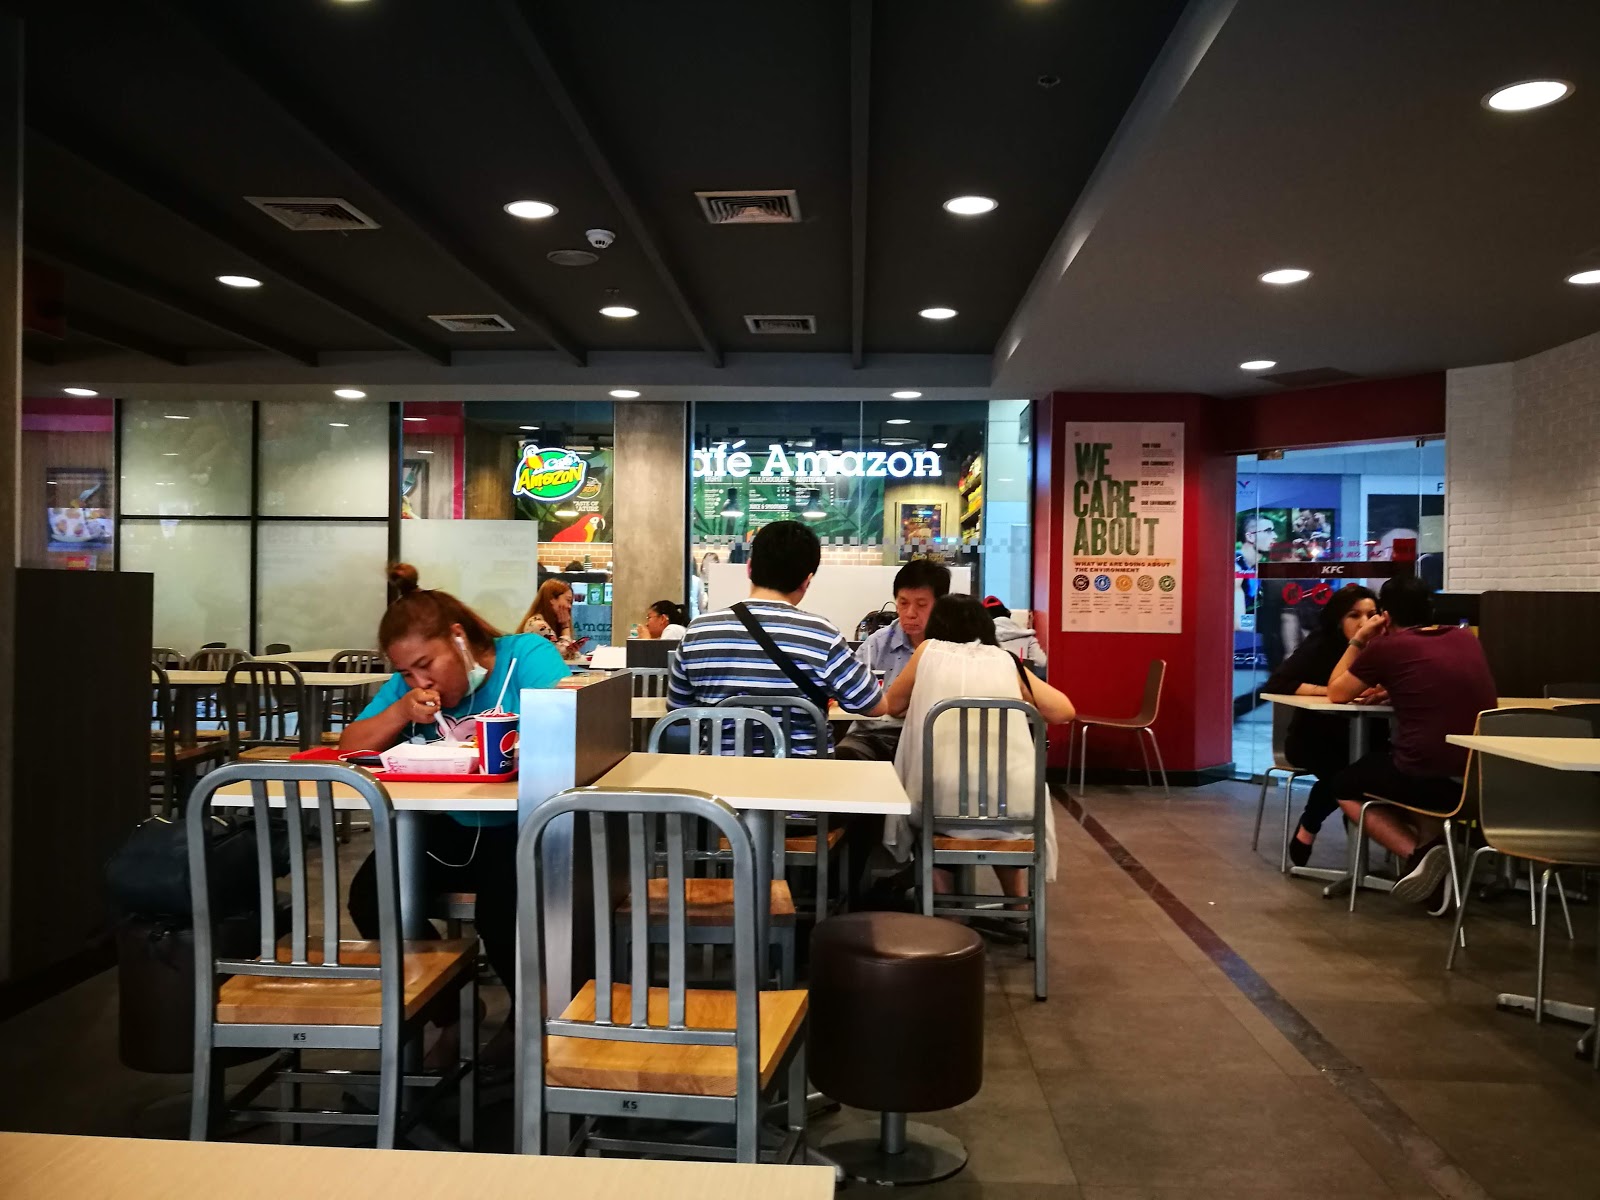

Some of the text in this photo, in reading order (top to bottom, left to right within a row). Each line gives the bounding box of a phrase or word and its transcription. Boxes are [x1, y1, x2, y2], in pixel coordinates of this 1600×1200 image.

[760, 444, 943, 477] Amazon
[1074, 442, 1113, 481] WE
[1073, 480, 1138, 518] CARE
[1073, 518, 1160, 556] ABOUT
[1321, 565, 1345, 574] KFC
